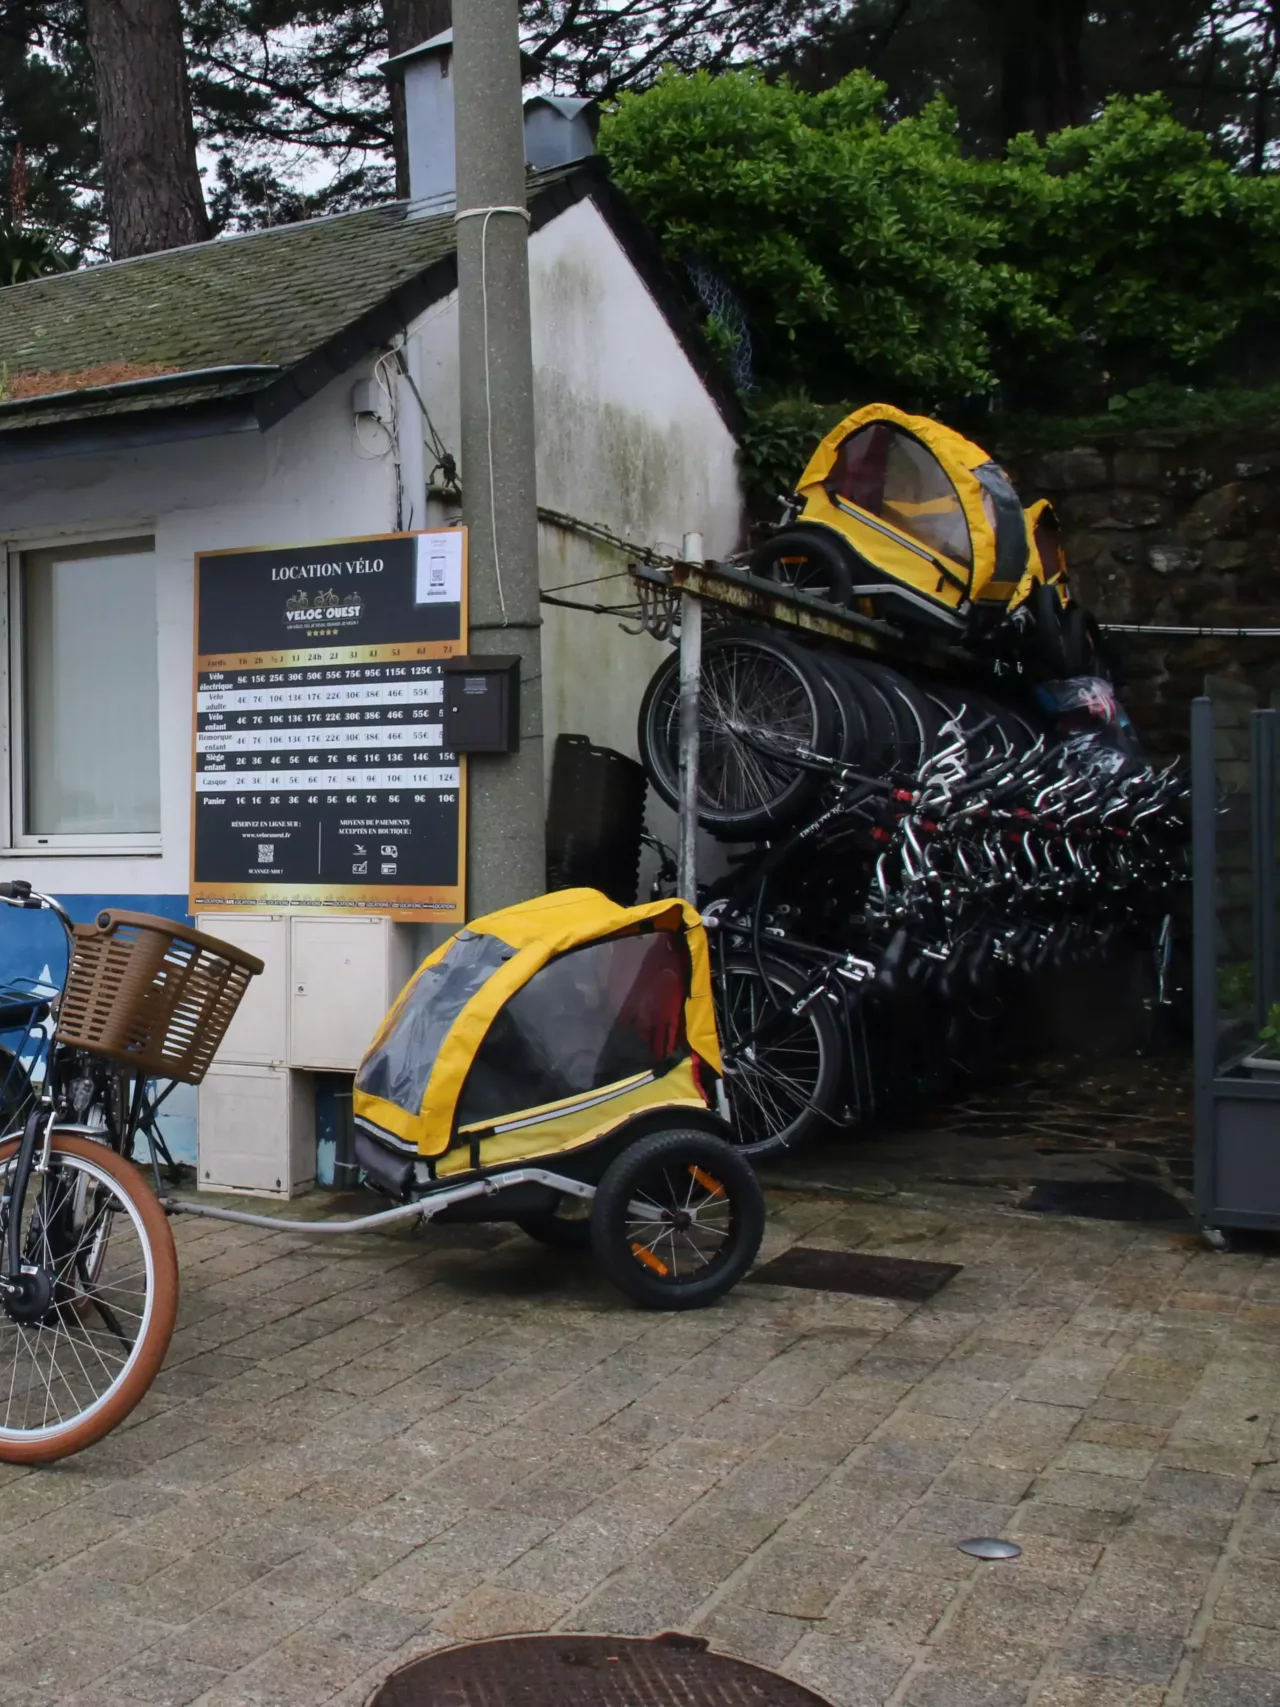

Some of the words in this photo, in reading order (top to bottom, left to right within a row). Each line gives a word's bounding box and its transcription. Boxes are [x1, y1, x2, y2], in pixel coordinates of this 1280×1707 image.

[272, 563, 342, 580] LOCATION
[346, 558, 383, 574] VÉLO
[286, 606, 361, 621] VELOC'OUEST
[270, 674, 284, 682] 25€
[288, 673, 302, 681] 30€
[307, 672, 321, 680] 50€
[326, 671, 341, 679] 55€
[345, 670, 361, 678] 75€
[365, 669, 380, 677] 95€
[385, 668, 406, 676] 115€
[411, 666, 432, 675] 125€
[365, 690, 379, 698] 38€
[253, 716, 263, 724] 7€
[269, 715, 283, 723] 10€
[325, 713, 341, 721] 22€
[345, 712, 360, 720] 30€
[364, 711, 380, 719] 38€
[387, 710, 403, 718] 46€
[413, 710, 429, 718] 55€
[206, 753, 224, 762] Siège
[365, 754, 380, 762] 11€
[413, 753, 429, 761] 14€
[439, 752, 455, 760] 15€
[203, 797, 226, 805] Panier
[270, 796, 280, 804] 2€
[289, 796, 299, 804] 3€
[366, 795, 377, 803] 7€
[389, 795, 399, 803] 8€
